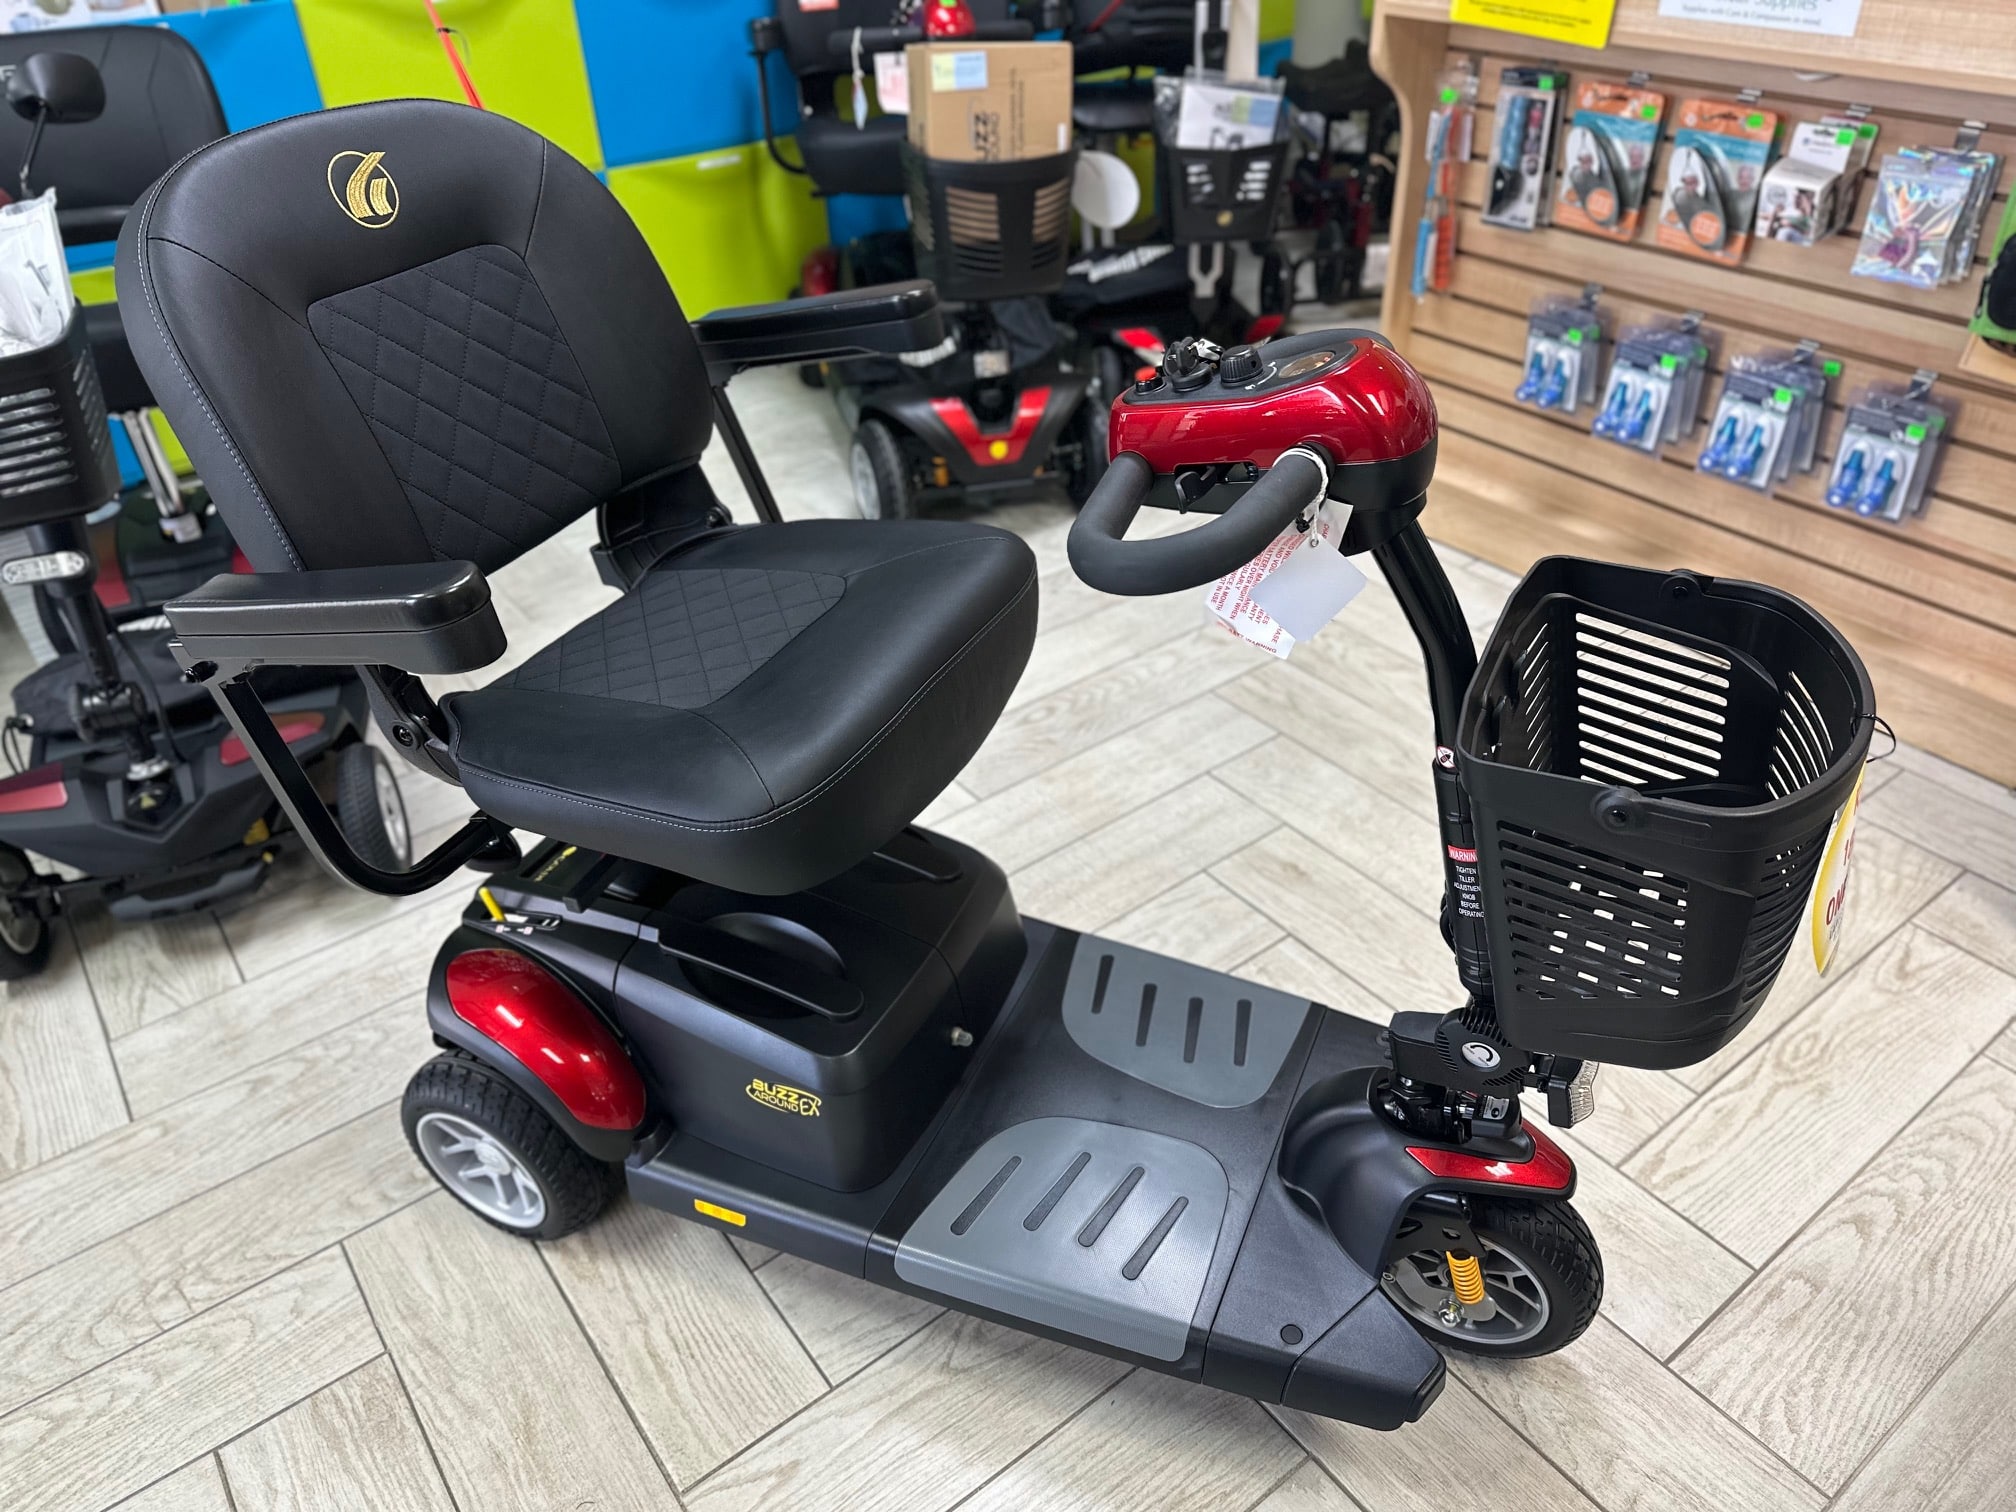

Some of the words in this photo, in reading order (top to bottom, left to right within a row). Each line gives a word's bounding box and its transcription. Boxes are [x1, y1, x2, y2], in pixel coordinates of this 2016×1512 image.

[1448, 849, 1478, 861] WARNIN
[1453, 881, 1481, 892] ADJUSTMEN
[1462, 892, 1476, 901] KNOB
[1460, 900, 1480, 909] BEFORE
[752, 1078, 799, 1105] BUZZ
[753, 1090, 799, 1112] AROUND
[800, 1098, 820, 1117] EX
